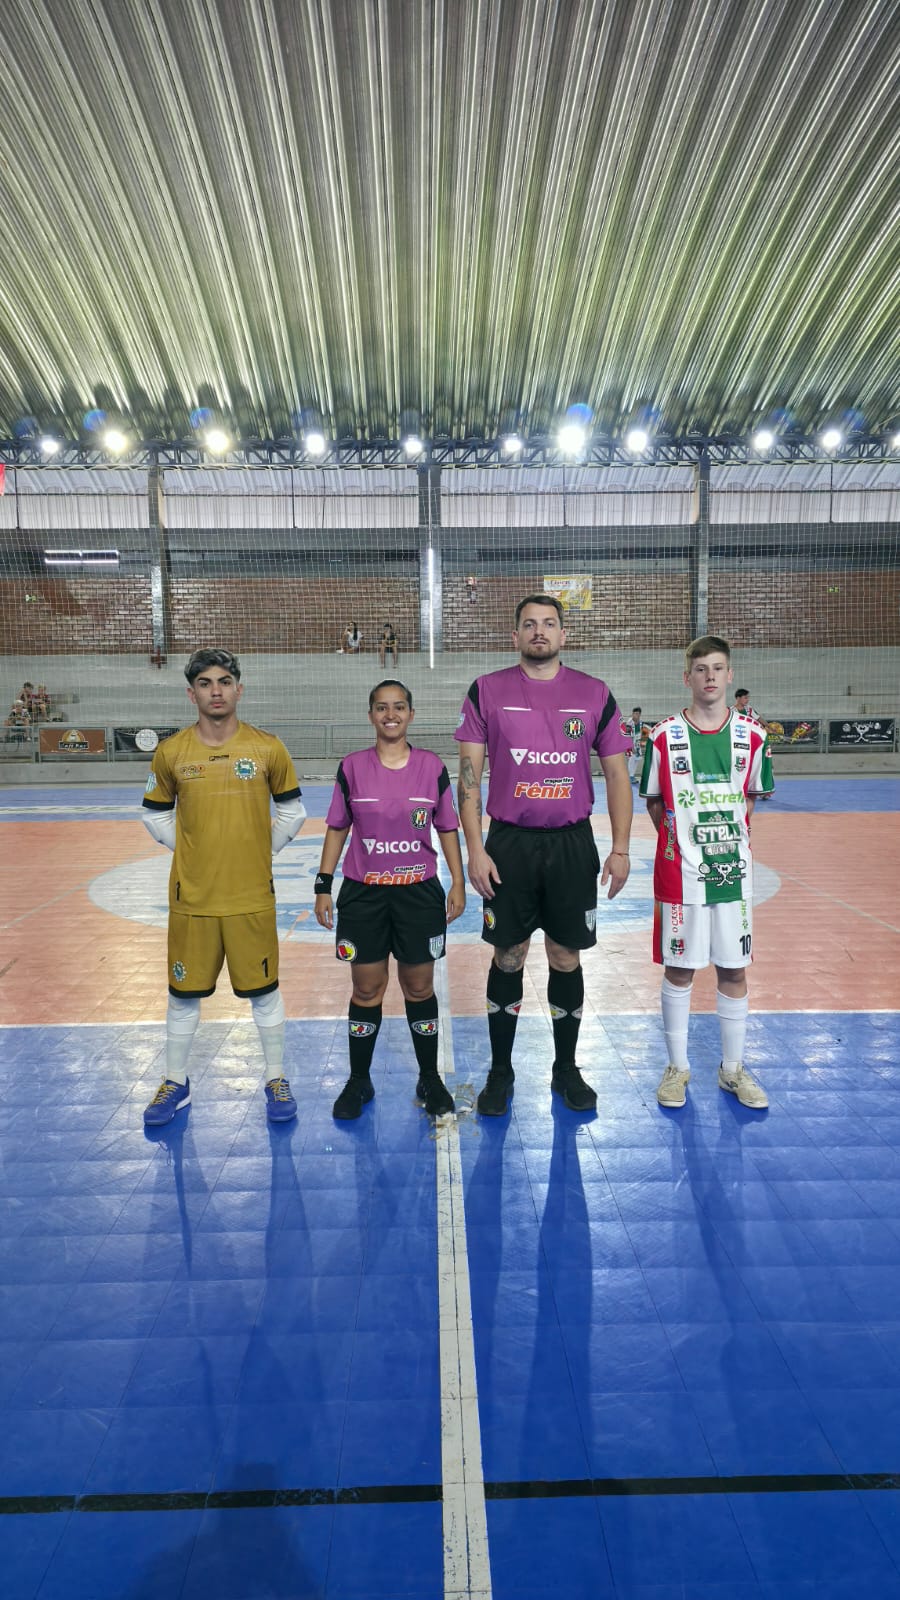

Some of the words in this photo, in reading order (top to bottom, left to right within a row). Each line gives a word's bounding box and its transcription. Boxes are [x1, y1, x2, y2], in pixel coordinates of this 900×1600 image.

[527, 751, 577, 765] SICOOB
[514, 782, 573, 799] Fênix
[375, 840, 421, 854] SICOO
[739, 934, 752, 956] 10
[261, 957, 269, 978] 1
